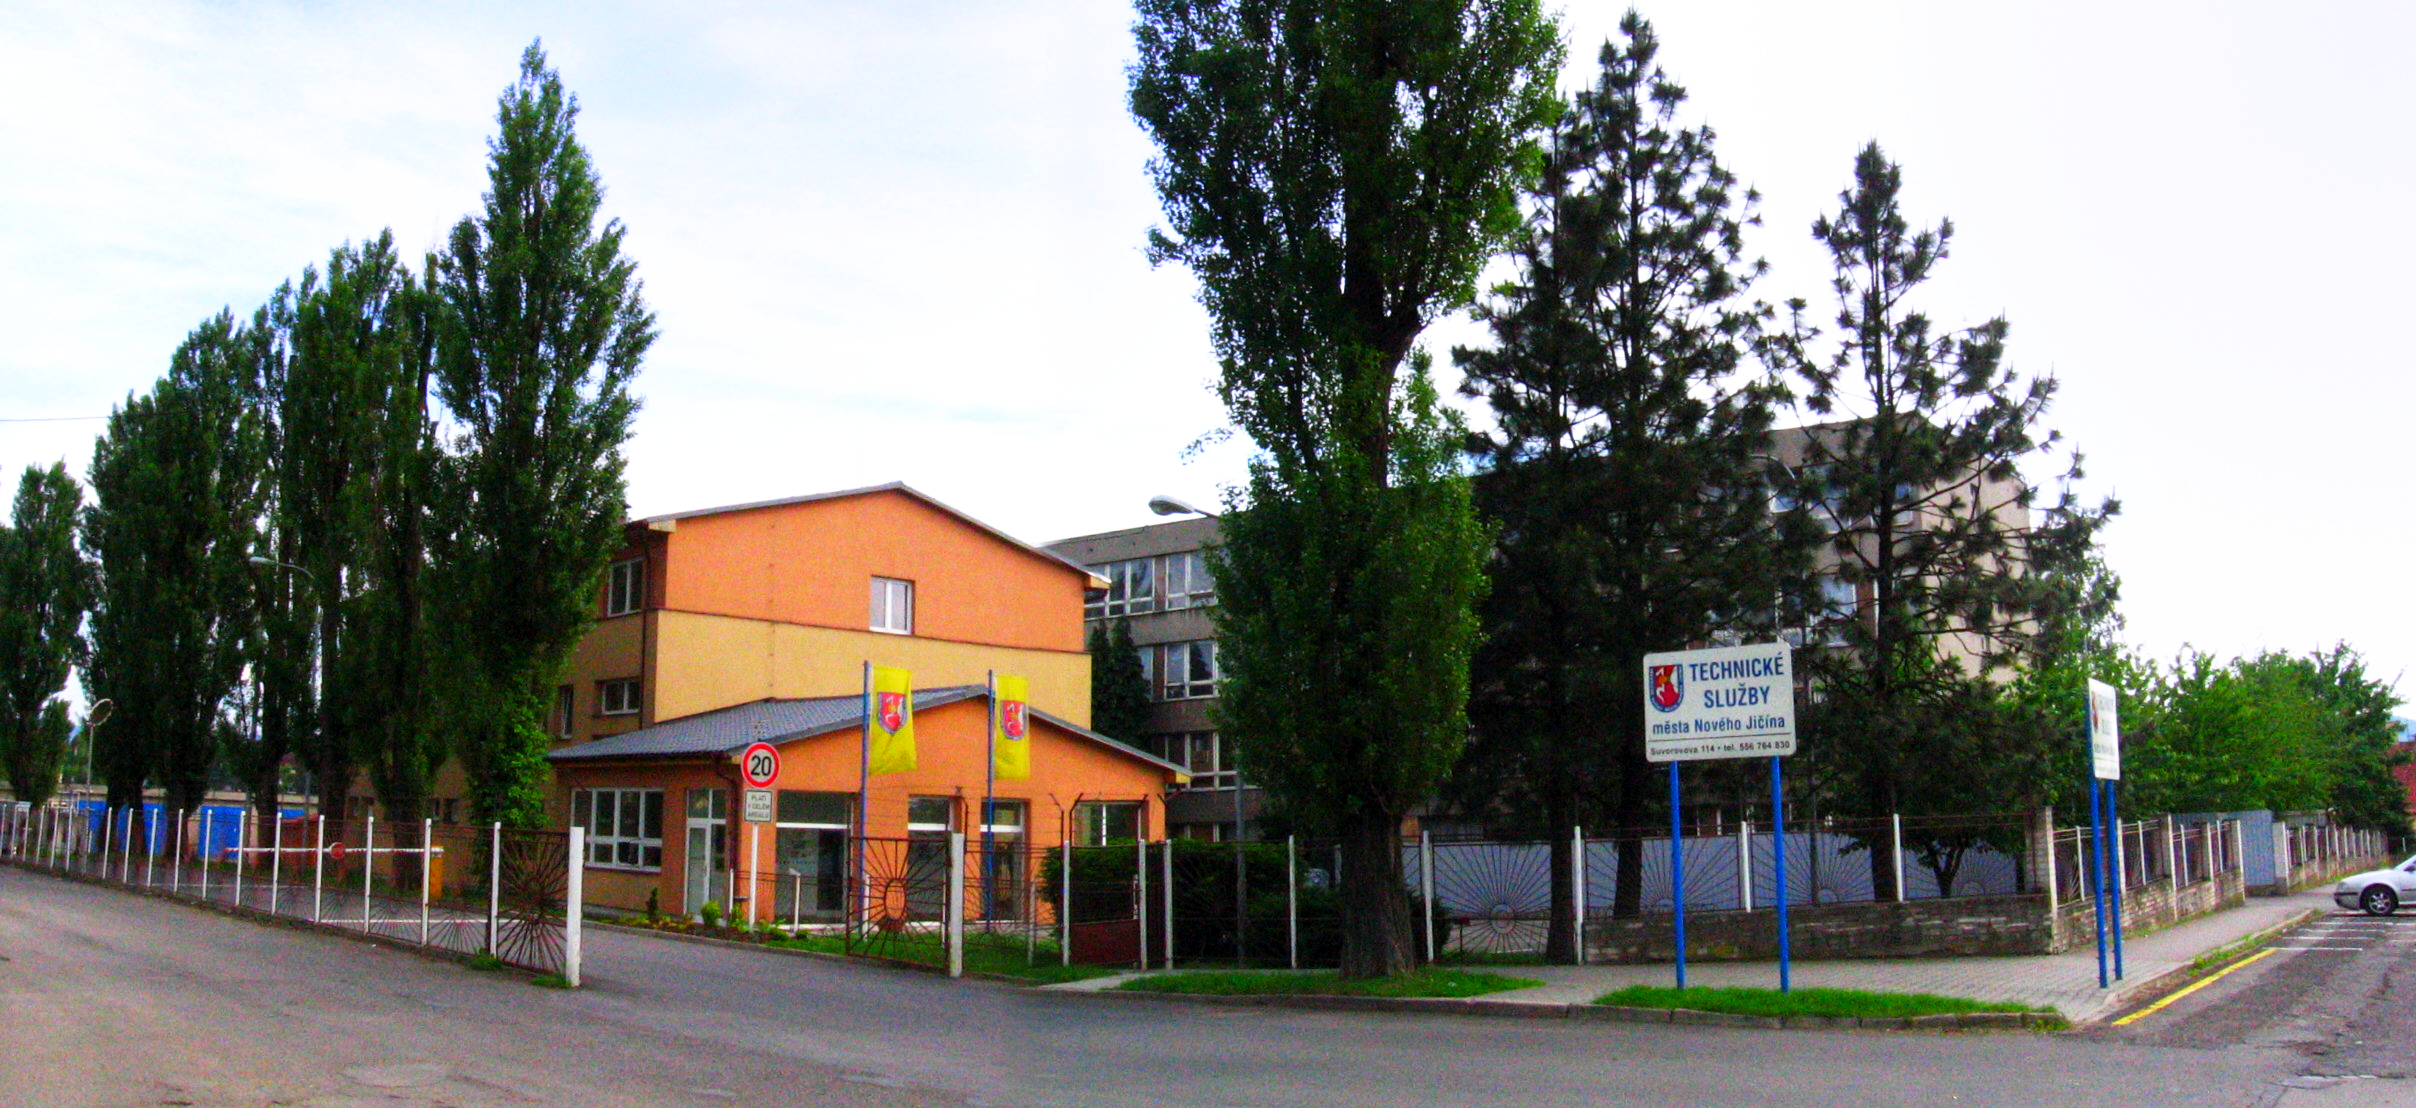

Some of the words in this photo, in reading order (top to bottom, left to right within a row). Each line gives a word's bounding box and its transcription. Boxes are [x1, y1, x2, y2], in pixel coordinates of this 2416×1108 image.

[1688, 652, 1784, 682] TECHNICKÉ
[1704, 682, 1770, 709] SLUŽBY
[1652, 721, 1690, 735] města
[1694, 717, 1741, 732] Nového
[1746, 715, 1785, 730] Jičína
[1702, 744, 1715, 752] 114
[1724, 743, 1736, 752] tel.
[751, 755, 772, 776] 20
